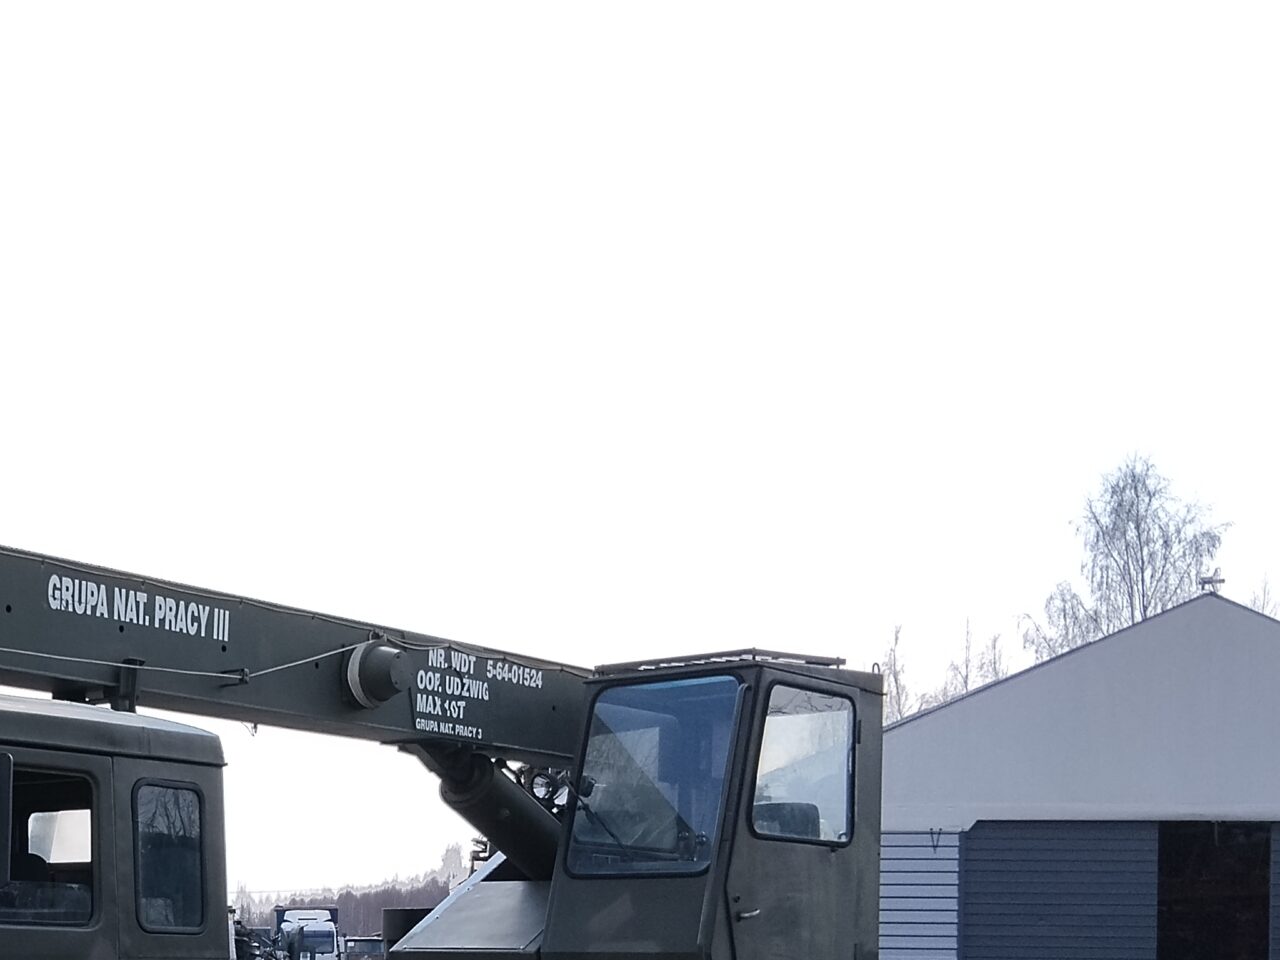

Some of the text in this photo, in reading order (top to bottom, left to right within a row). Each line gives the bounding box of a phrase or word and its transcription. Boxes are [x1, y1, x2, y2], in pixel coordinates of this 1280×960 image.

[47, 574, 230, 642] GRUPA NAT. PRACY III
[428, 648, 543, 688] NR. WDT 5-64-01524
[416, 693, 466, 719] MAX 10T
[415, 718, 482, 739] GRUPA NAT. PRACY 3
